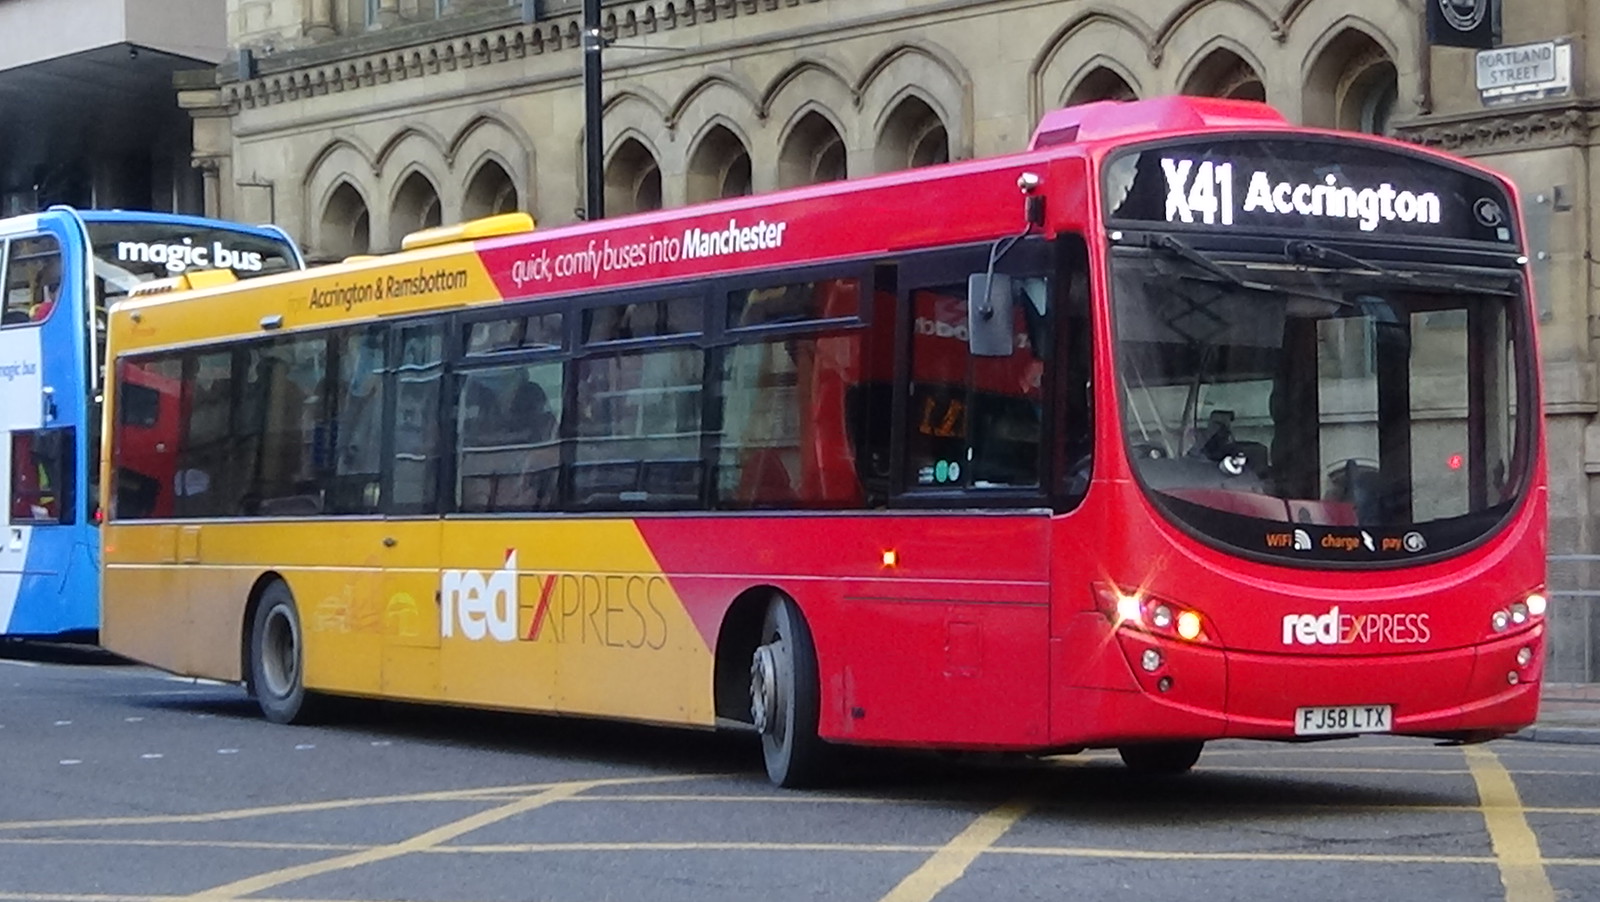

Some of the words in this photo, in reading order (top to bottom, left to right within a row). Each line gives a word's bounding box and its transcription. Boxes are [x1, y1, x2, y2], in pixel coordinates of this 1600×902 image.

[1479, 47, 1551, 68] PORTLAND
[1490, 65, 1540, 83] STREET
[1160, 157, 1234, 226] X41
[1243, 171, 1441, 232] Accrington
[117, 236, 208, 272] magic
[213, 241, 262, 271] bus
[554, 240, 601, 279] comfy
[603, 239, 646, 271] buses
[649, 235, 680, 263] into
[682, 218, 786, 260] Manchester
[309, 281, 373, 312] Accrington
[375, 276, 384, 300] &
[386, 267, 467, 298] Ramsbottom
[1321, 534, 1360, 550] charge
[1382, 537, 1402, 550] pay
[1303, 709, 1348, 730] FJ58
[1352, 707, 1386, 728] LTX
